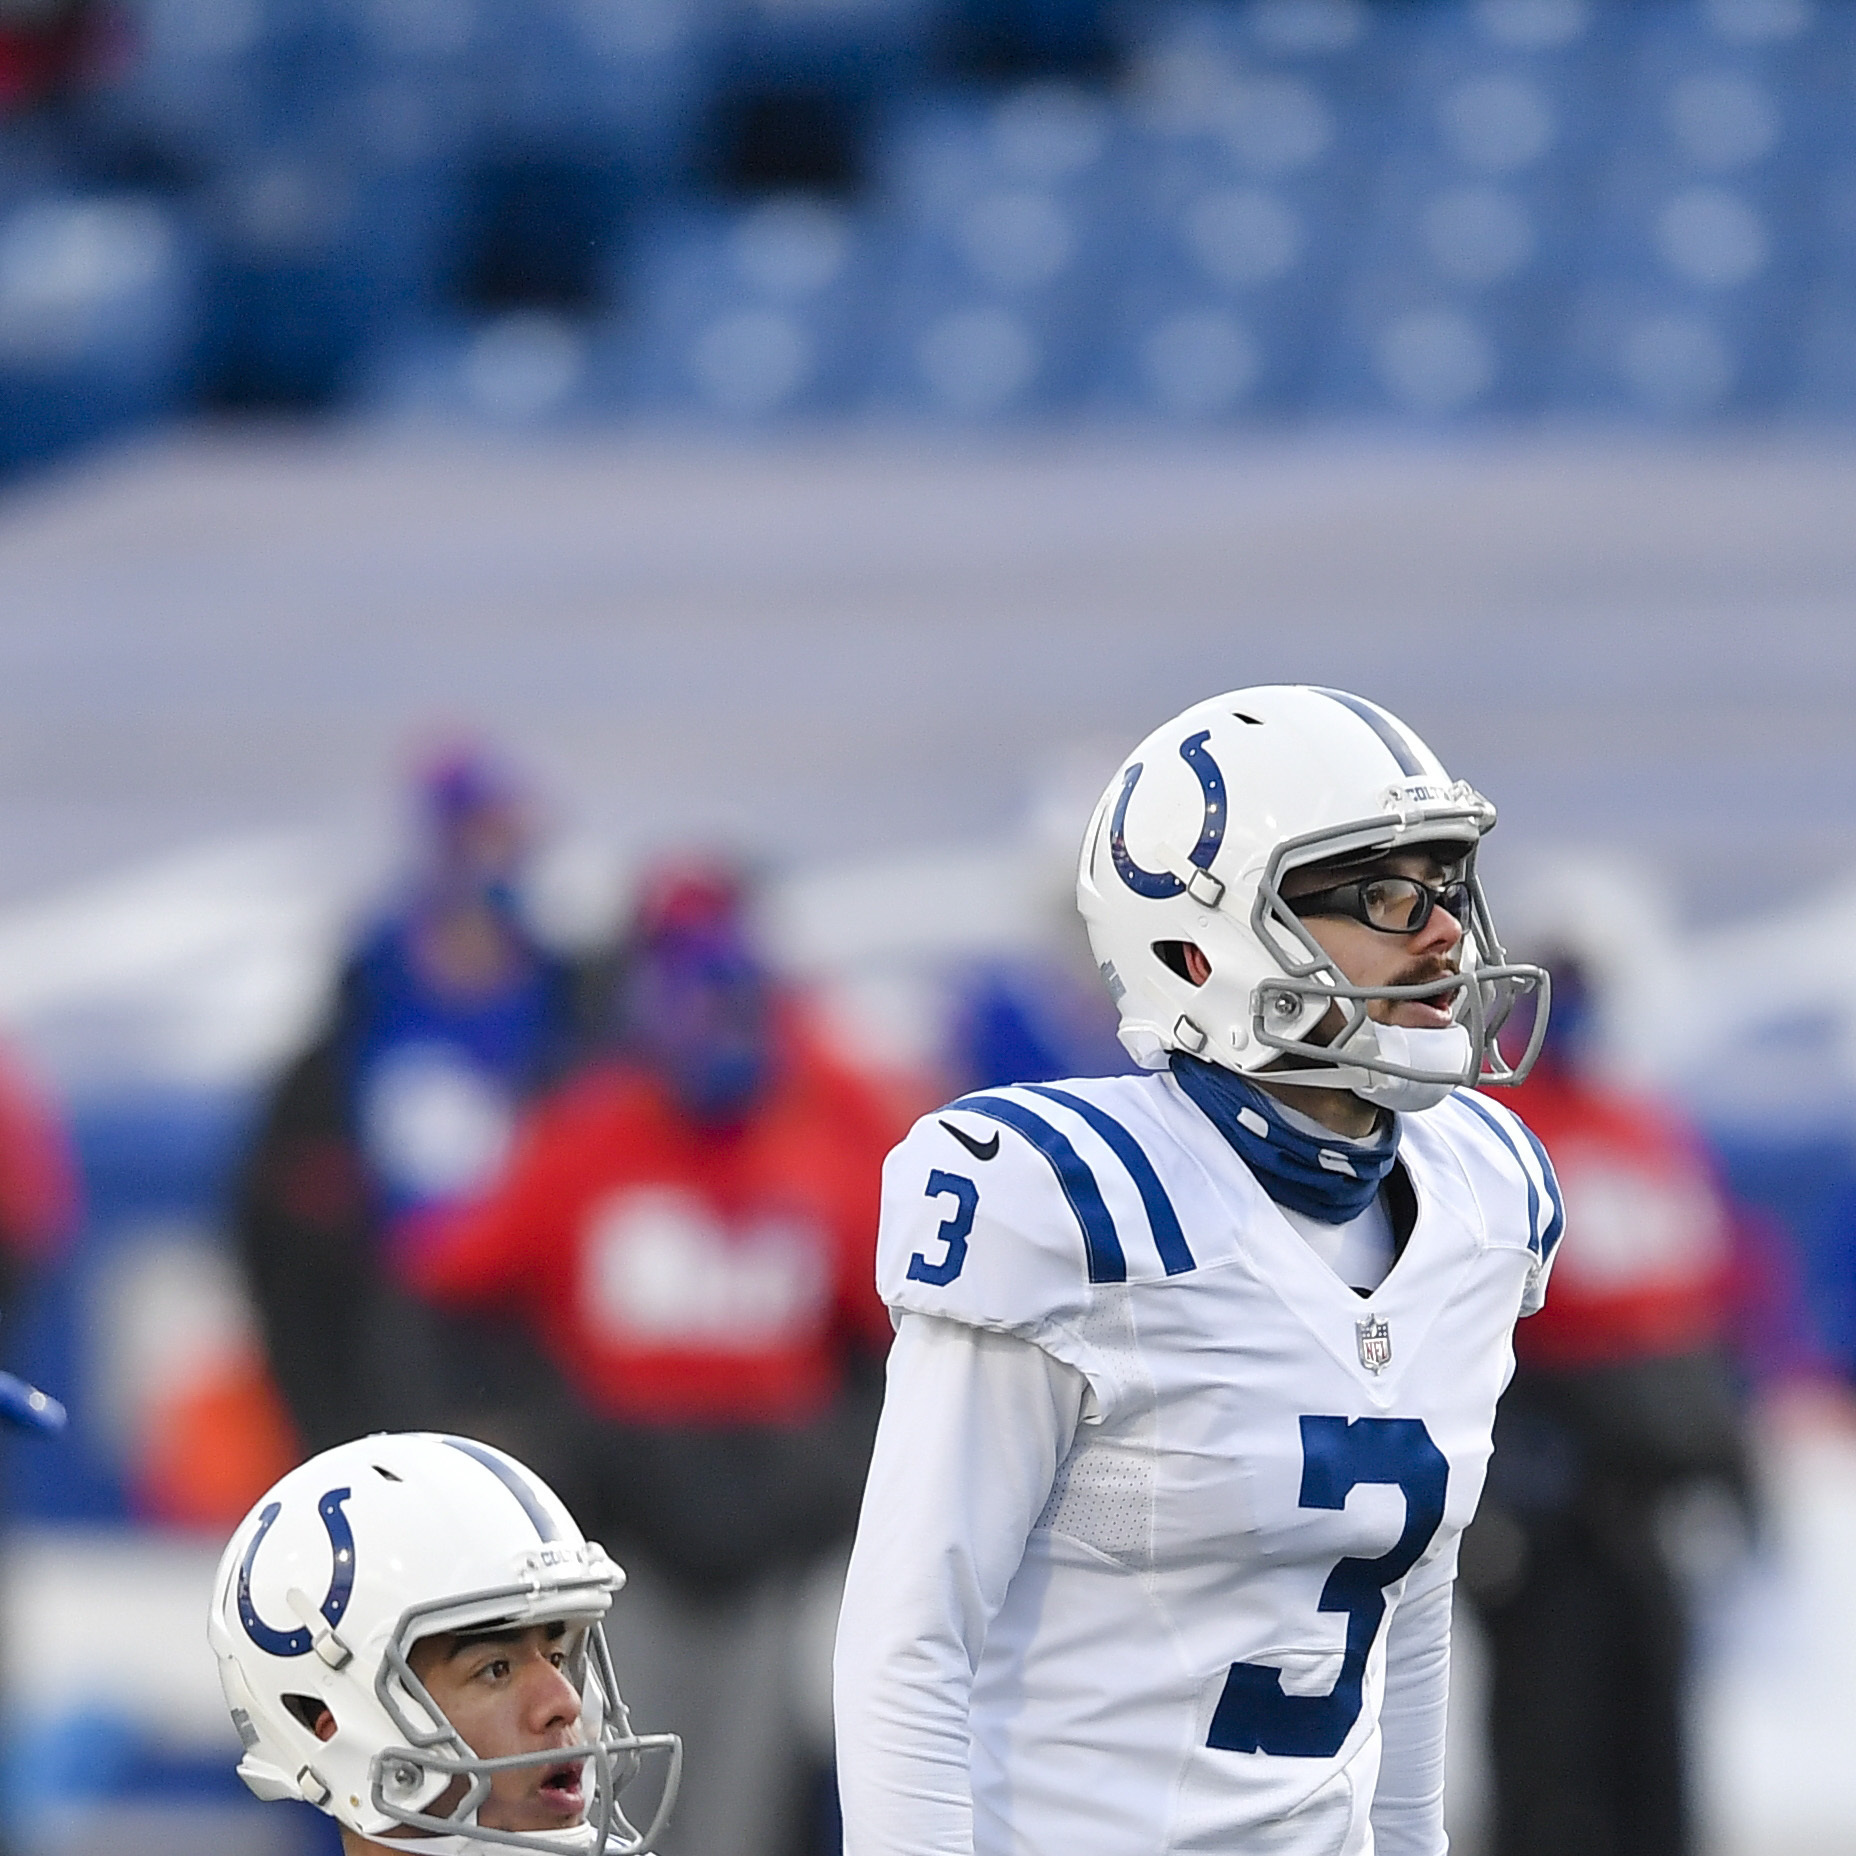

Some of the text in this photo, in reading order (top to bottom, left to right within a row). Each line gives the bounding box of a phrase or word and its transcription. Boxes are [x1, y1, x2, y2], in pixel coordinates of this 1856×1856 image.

[906, 1168, 979, 1287] 3
[1365, 1341, 1387, 1363] NFL
[1205, 1415, 1450, 1758] 3
